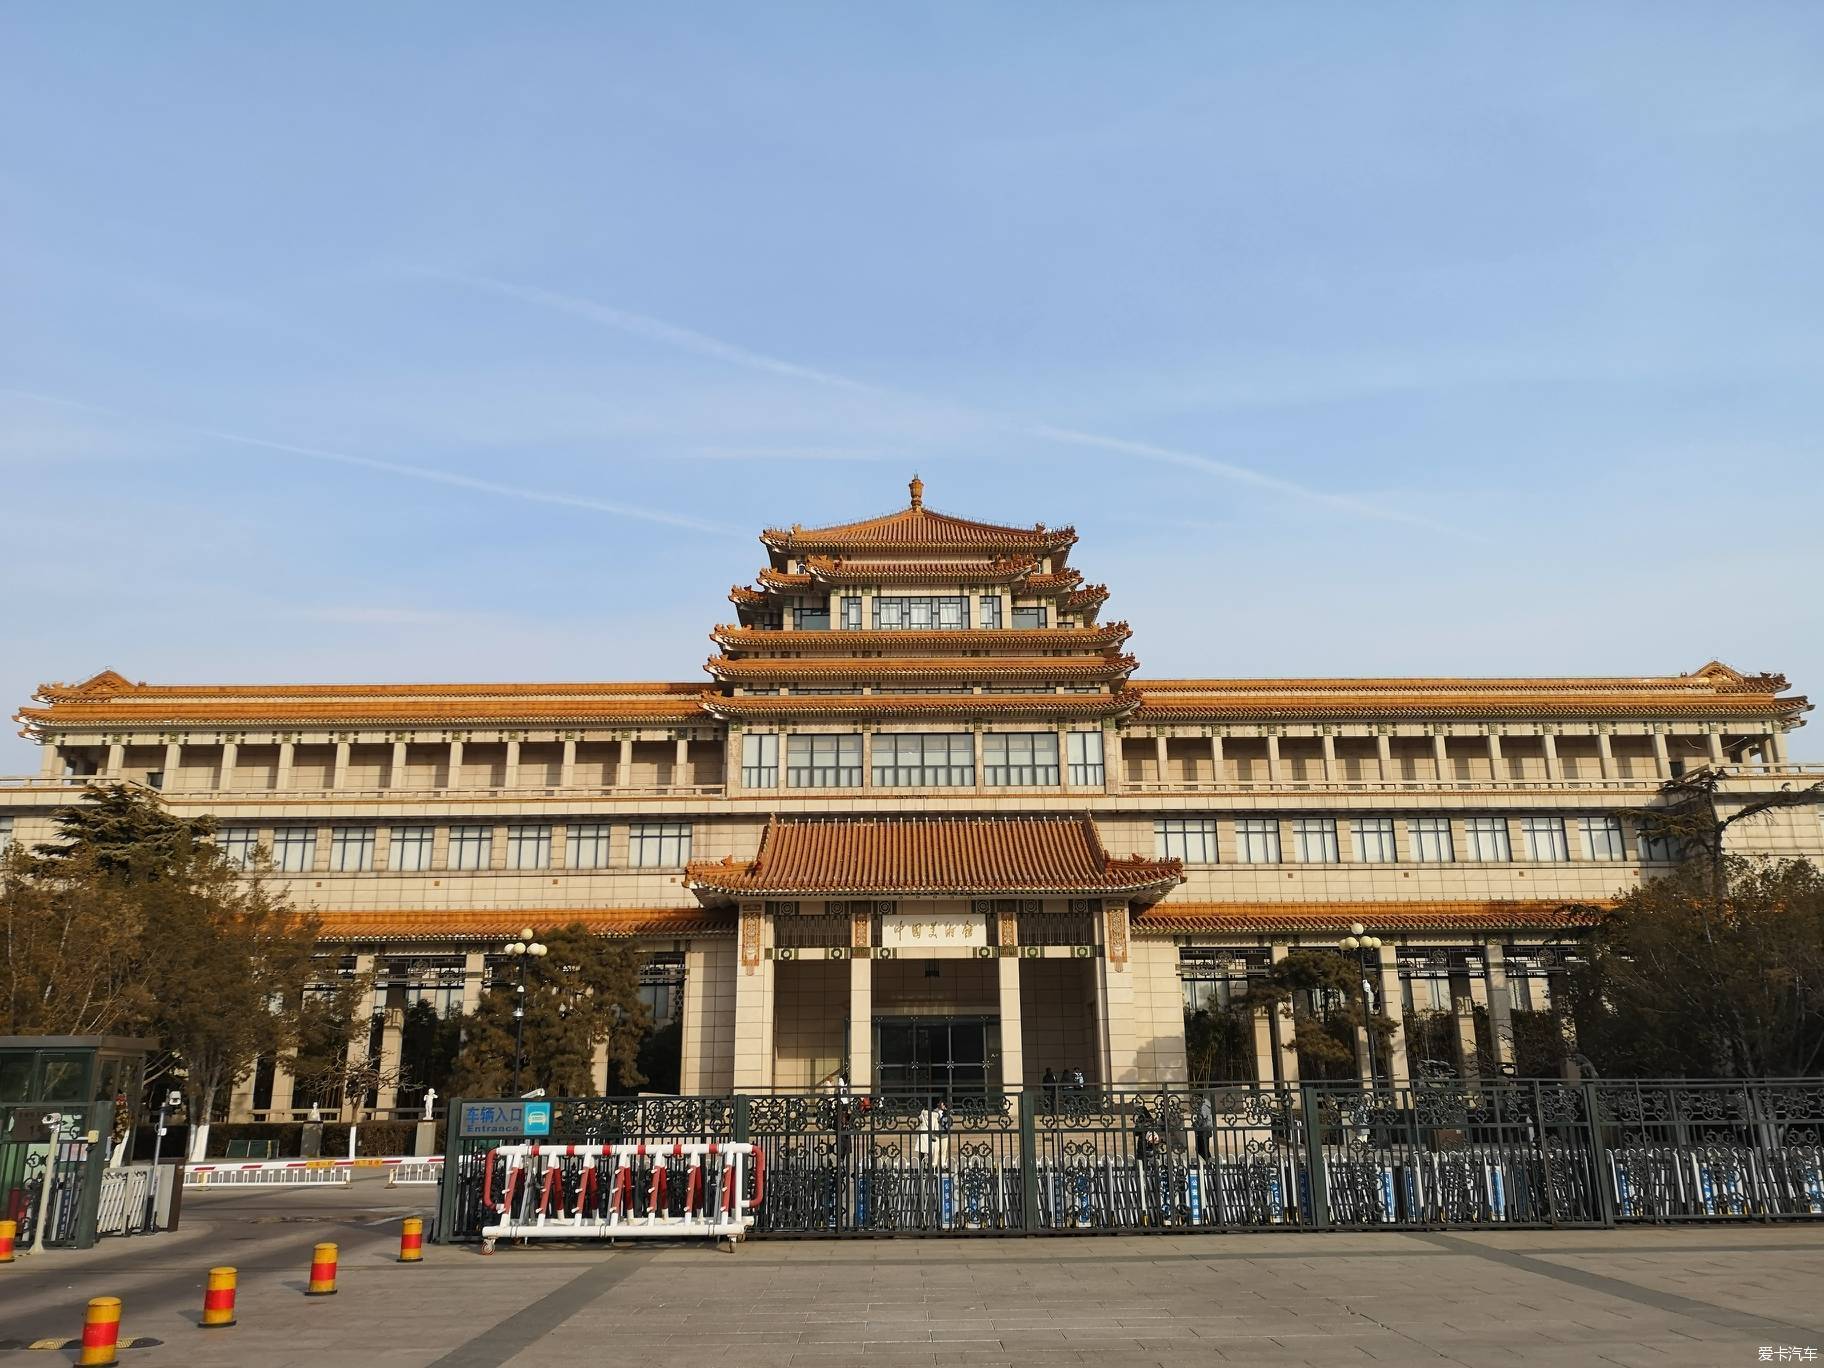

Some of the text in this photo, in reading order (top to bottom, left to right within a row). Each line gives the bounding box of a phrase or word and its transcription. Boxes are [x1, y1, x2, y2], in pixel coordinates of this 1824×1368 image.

[466, 1107, 522, 1123] 车辆入口
[466, 1125, 519, 1133] Entrance
